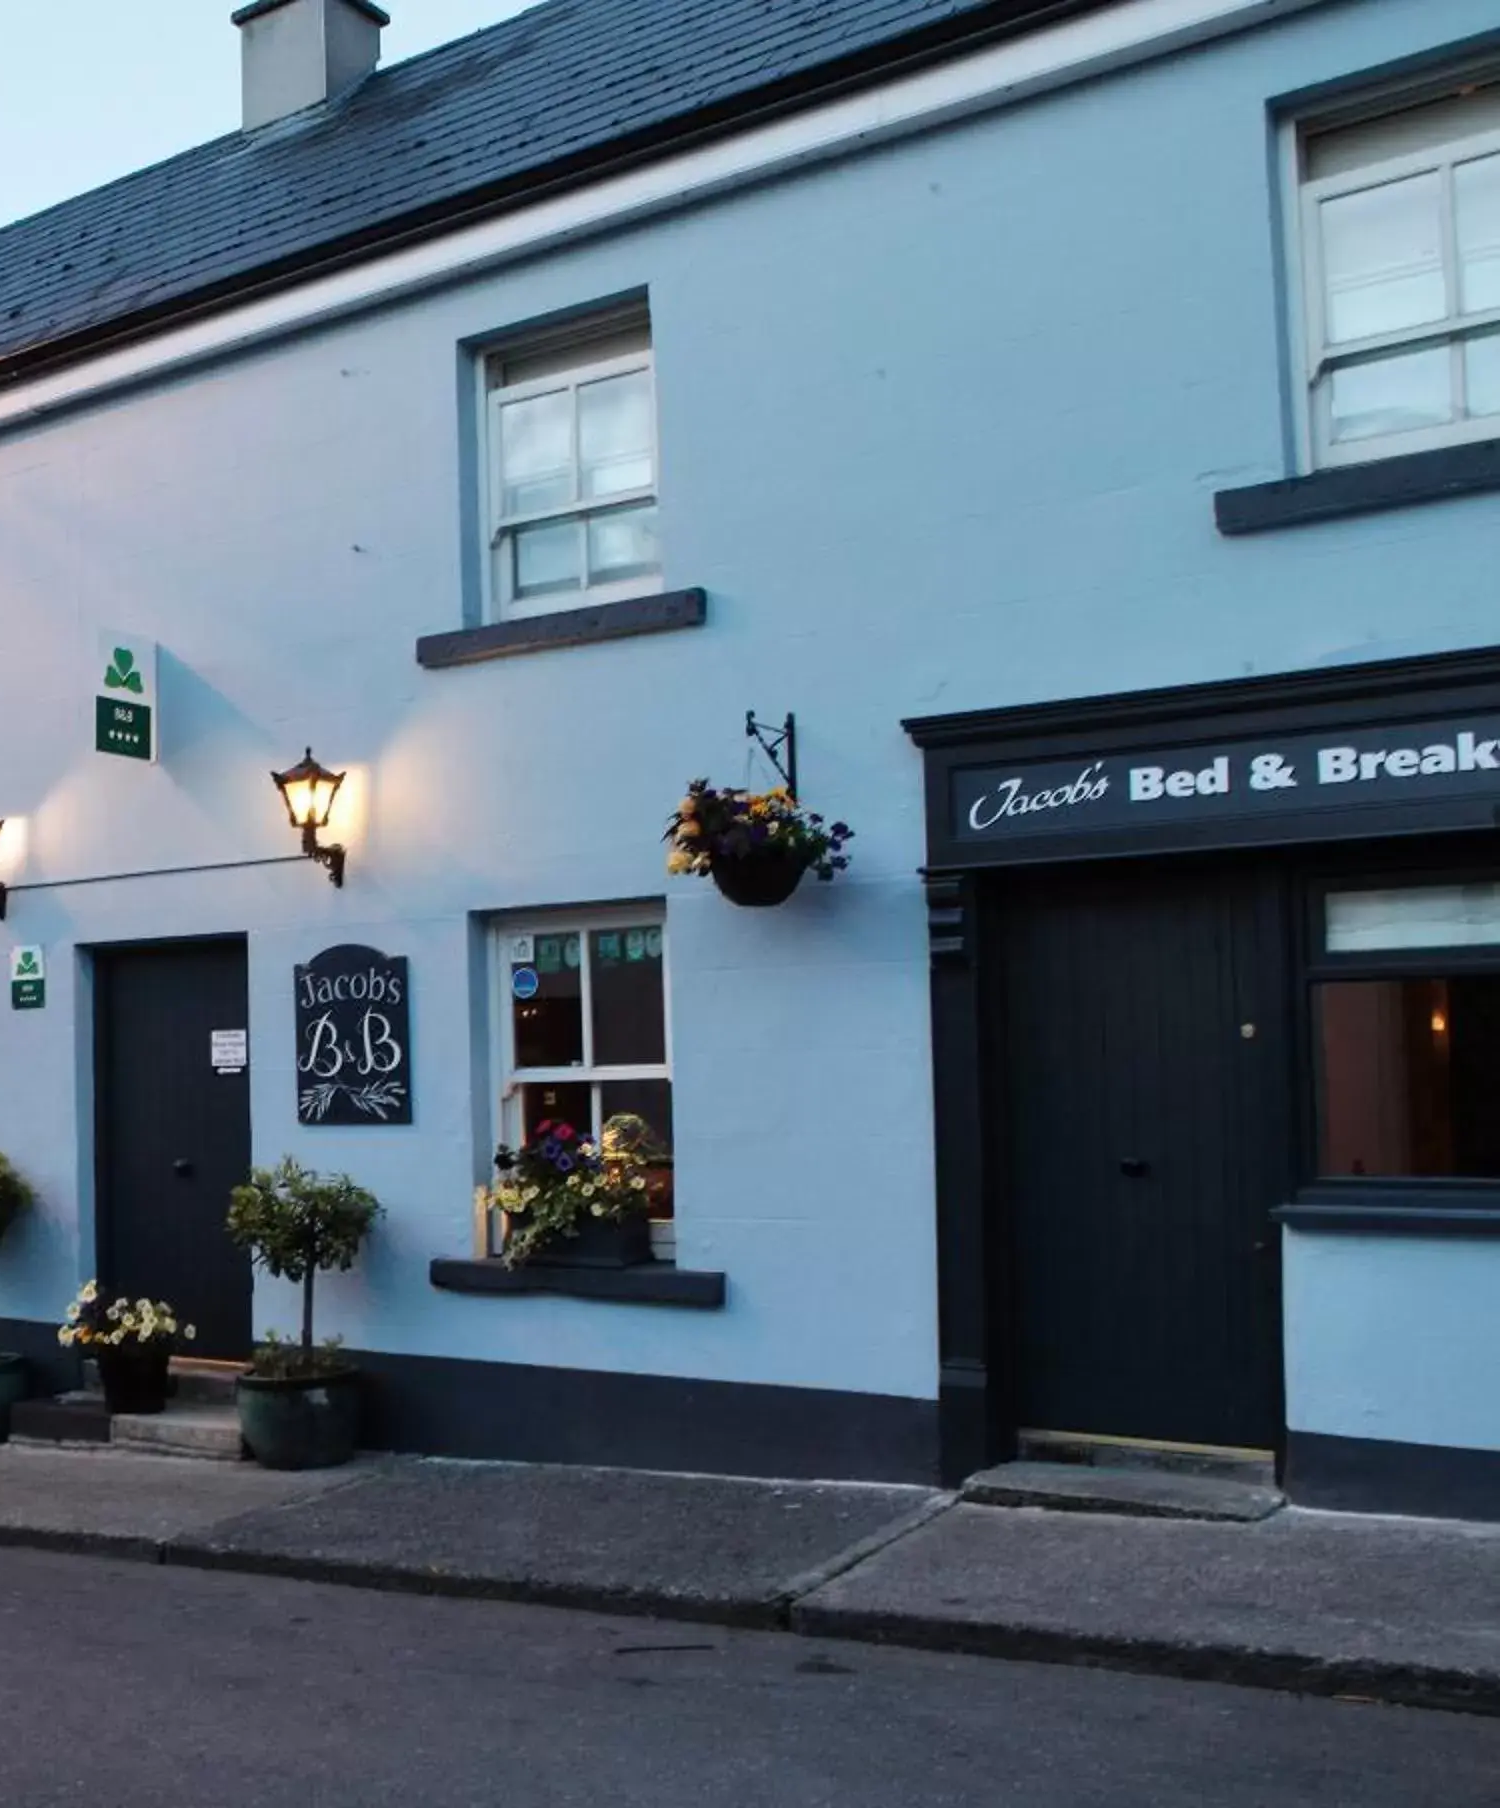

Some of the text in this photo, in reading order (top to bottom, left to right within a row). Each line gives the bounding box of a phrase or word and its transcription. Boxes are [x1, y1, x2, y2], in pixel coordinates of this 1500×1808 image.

[969, 731, 1500, 830] Jacob's Bed & Break
[299, 967, 401, 1009] Jacob's
